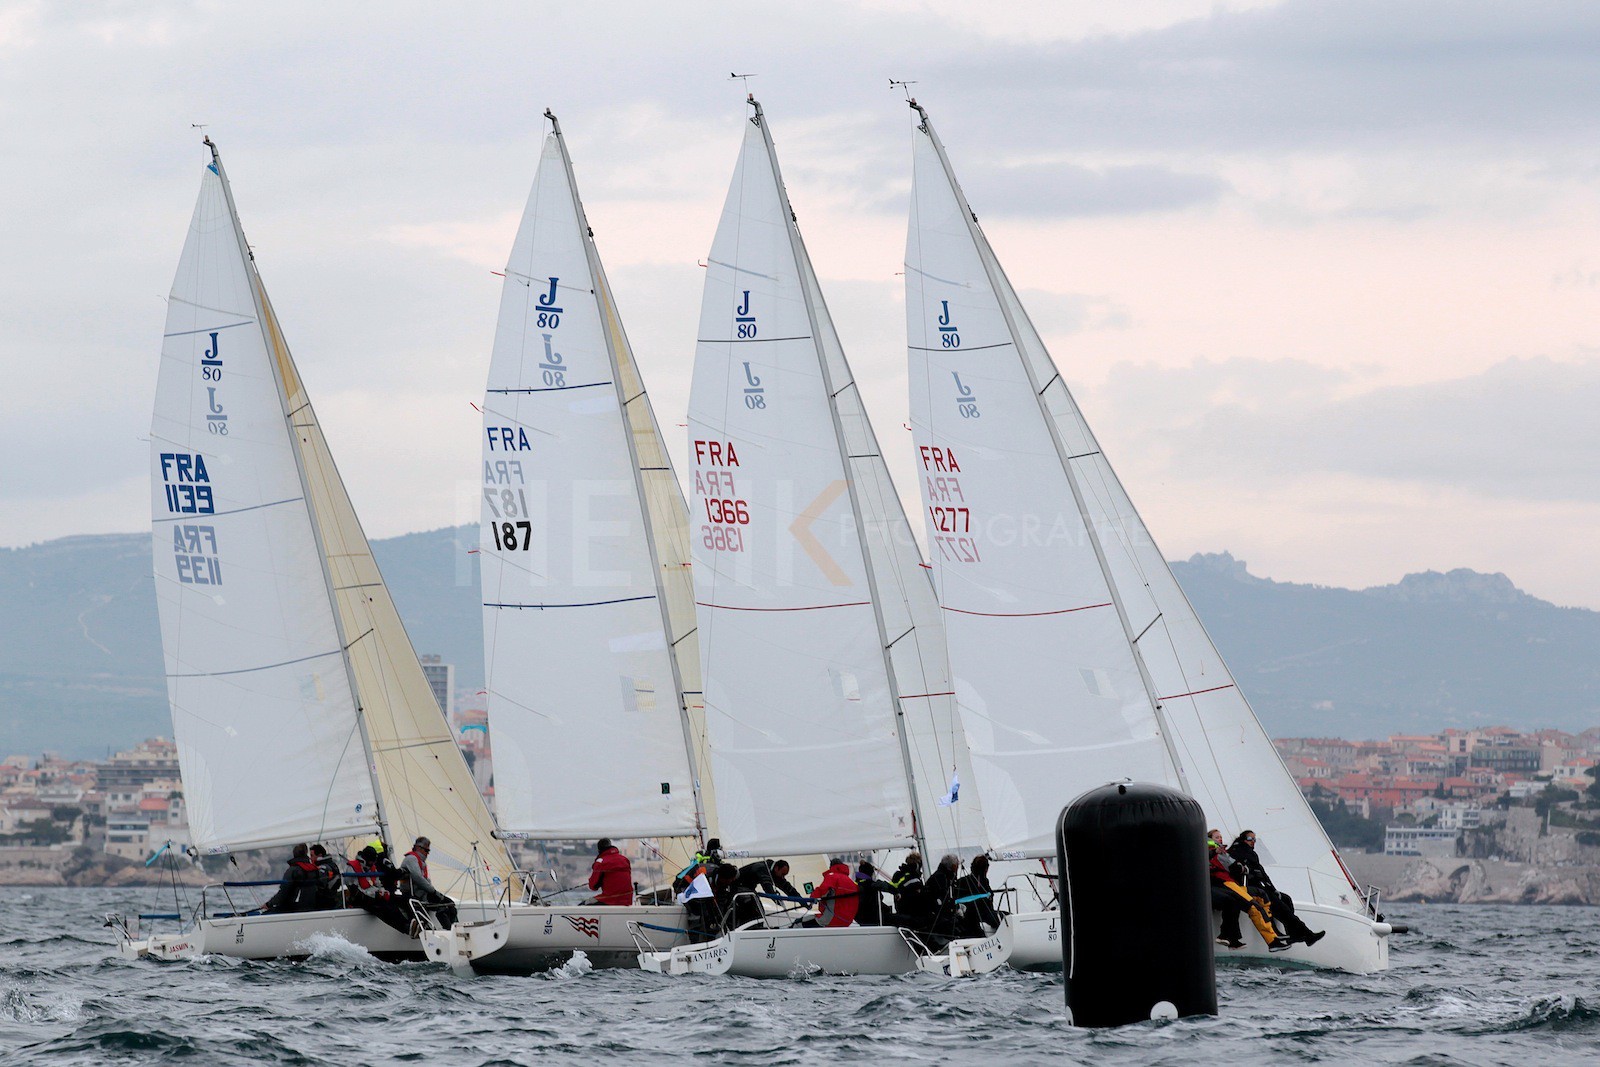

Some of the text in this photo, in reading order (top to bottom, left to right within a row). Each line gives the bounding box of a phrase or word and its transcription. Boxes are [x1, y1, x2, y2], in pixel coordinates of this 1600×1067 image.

[539, 277, 560, 306] J
[736, 290, 750, 316] J
[536, 312, 560, 329] 80
[938, 300, 950, 326] J
[737, 323, 757, 339] 80
[942, 333, 961, 348] 80
[204, 332, 219, 359] J
[202, 366, 222, 382] 80
[486, 427, 532, 451] FRA
[694, 440, 740, 467] FRA
[919, 446, 961, 473] FRA
[160, 453, 210, 483] FRA
[165, 484, 215, 514] 1139
[704, 498, 750, 525] 1366
[928, 506, 970, 533] 1277
[491, 520, 532, 551] 187
[1049, 918, 1056, 930] J
[169, 943, 189, 953] JASMIN
[692, 948, 728, 962] ANTARES
[768, 937, 776, 949] J
[972, 938, 1001, 956] CAPELLA
